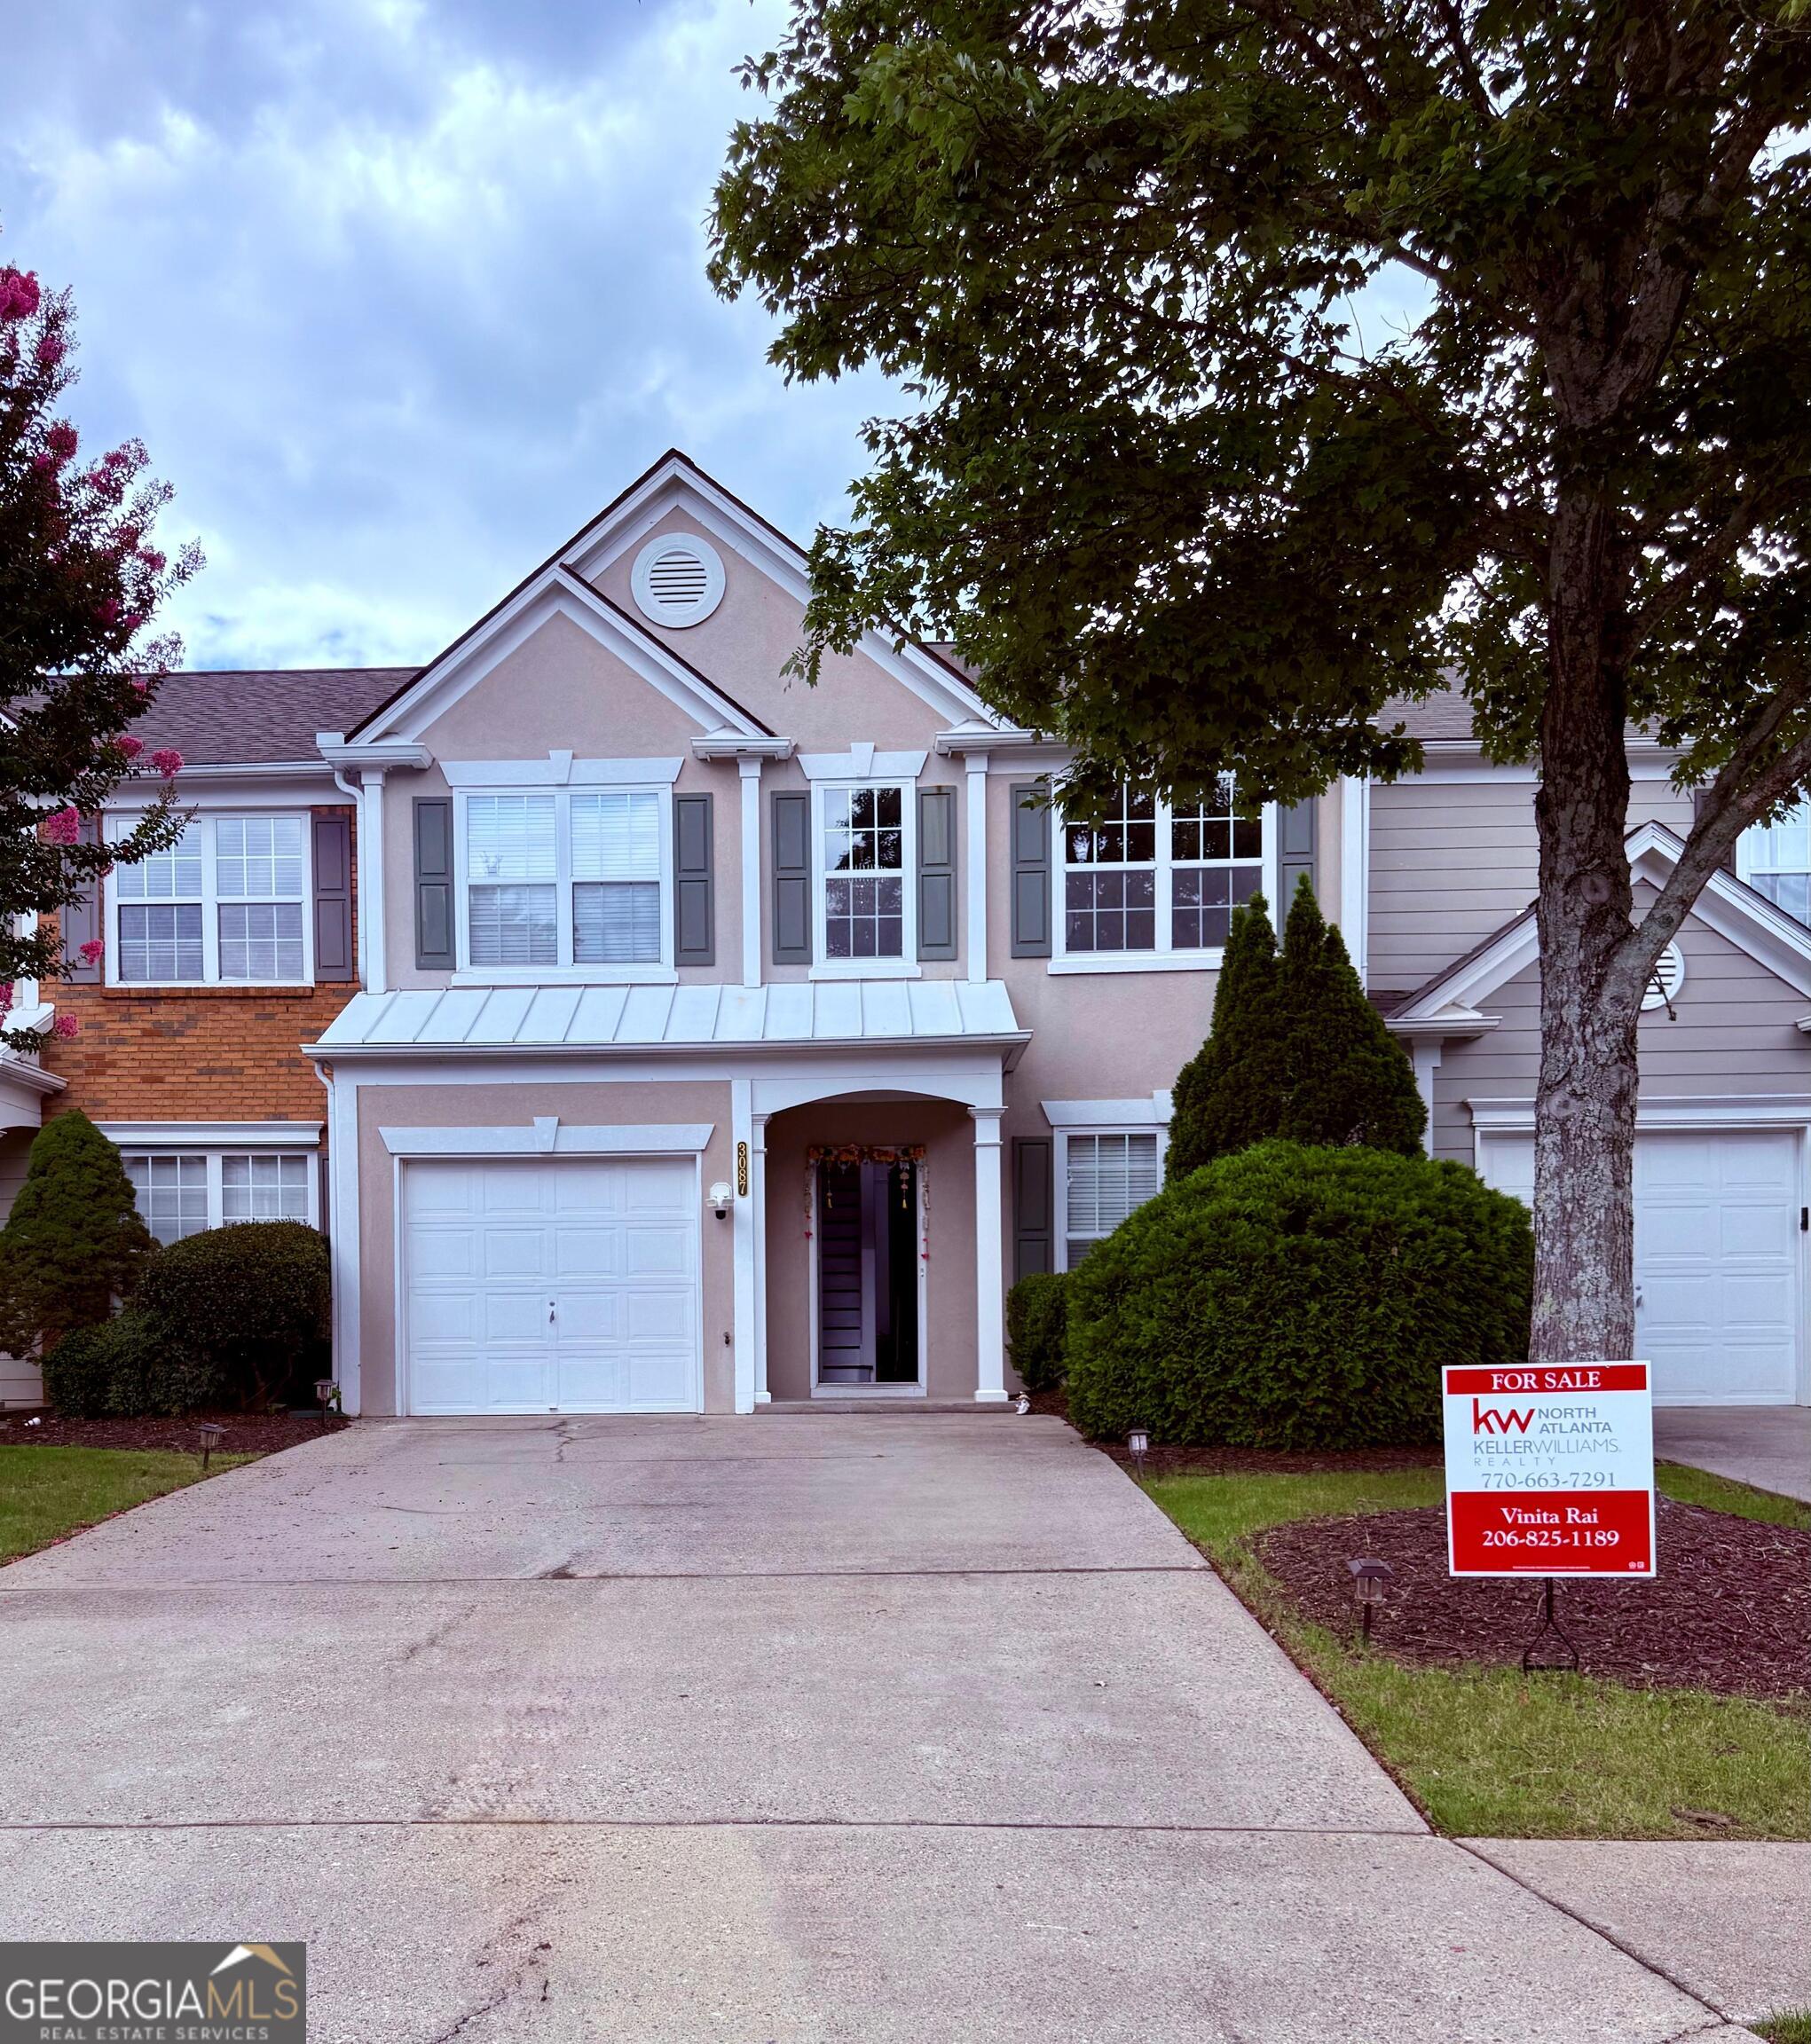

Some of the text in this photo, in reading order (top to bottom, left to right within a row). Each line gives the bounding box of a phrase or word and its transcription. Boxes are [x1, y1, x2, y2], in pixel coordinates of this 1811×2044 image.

[1491, 1371, 1602, 1390] FOR SALE
[1472, 1397, 1535, 1435] kw
[1538, 1407, 1596, 1419] NORTH
[1539, 1421, 1612, 1434] ATLANTA
[1474, 1457, 1555, 1466] REALTY
[1481, 1472, 1616, 1489] 770-663-7291
[1500, 1507, 1599, 1524] Vinita Rai
[1482, 1530, 1619, 1547] 206-825-1189
